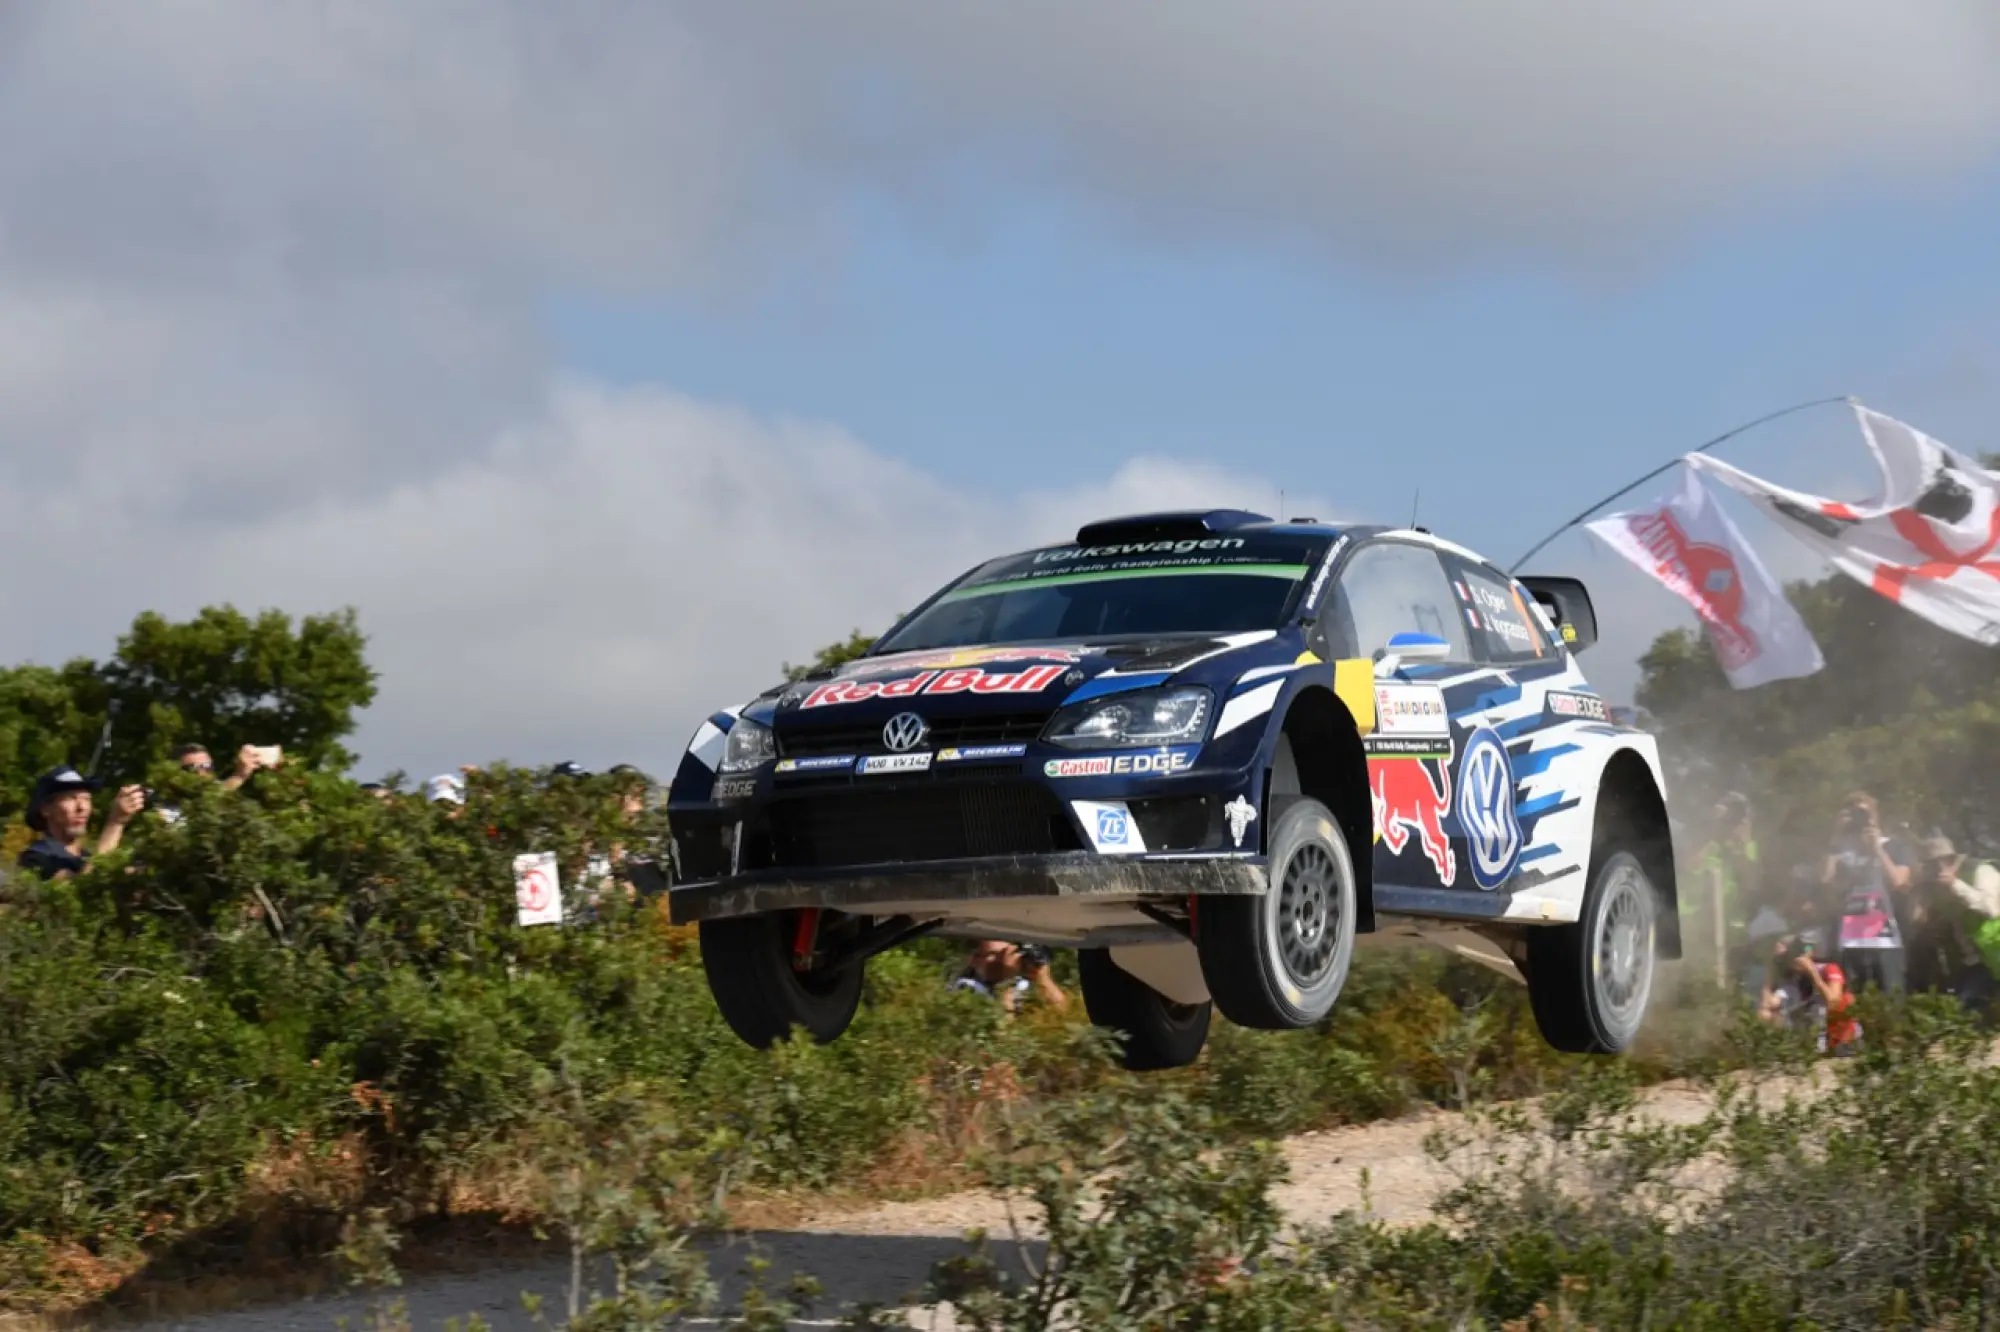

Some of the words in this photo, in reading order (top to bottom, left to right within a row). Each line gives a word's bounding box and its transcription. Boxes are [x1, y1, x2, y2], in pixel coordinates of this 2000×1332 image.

[1033, 537, 1245, 565] Volkswagen
[1112, 556, 1212, 569] Championship
[801, 670, 940, 709] Red
[923, 665, 1070, 694] Bull
[1574, 696, 1606, 720] EDGE
[1060, 760, 1109, 775] Castrol
[1113, 752, 1187, 774] EDGE
[1103, 818, 1121, 834] ZF
